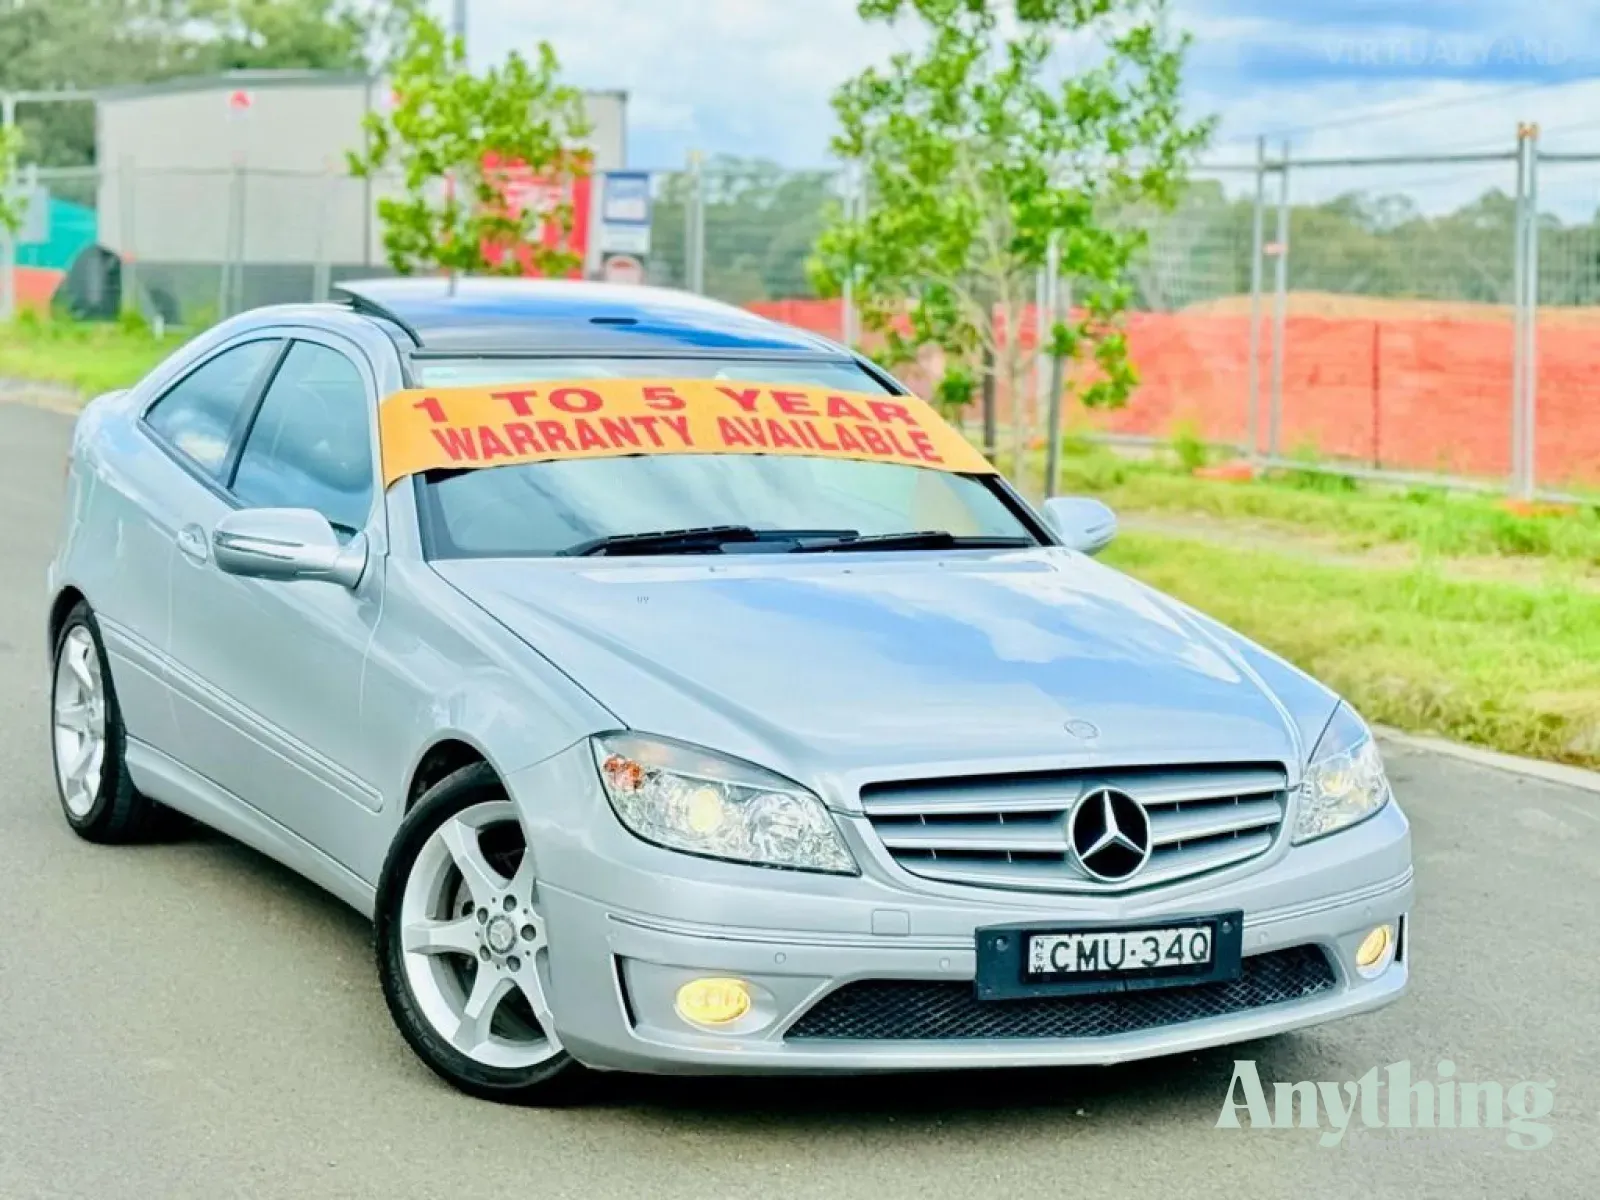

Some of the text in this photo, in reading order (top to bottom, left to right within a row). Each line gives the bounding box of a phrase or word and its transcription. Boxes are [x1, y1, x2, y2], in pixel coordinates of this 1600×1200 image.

[413, 387, 919, 426] 1 TO 5 YEAR
[430, 415, 944, 463] WARRANTY AVAILABLE
